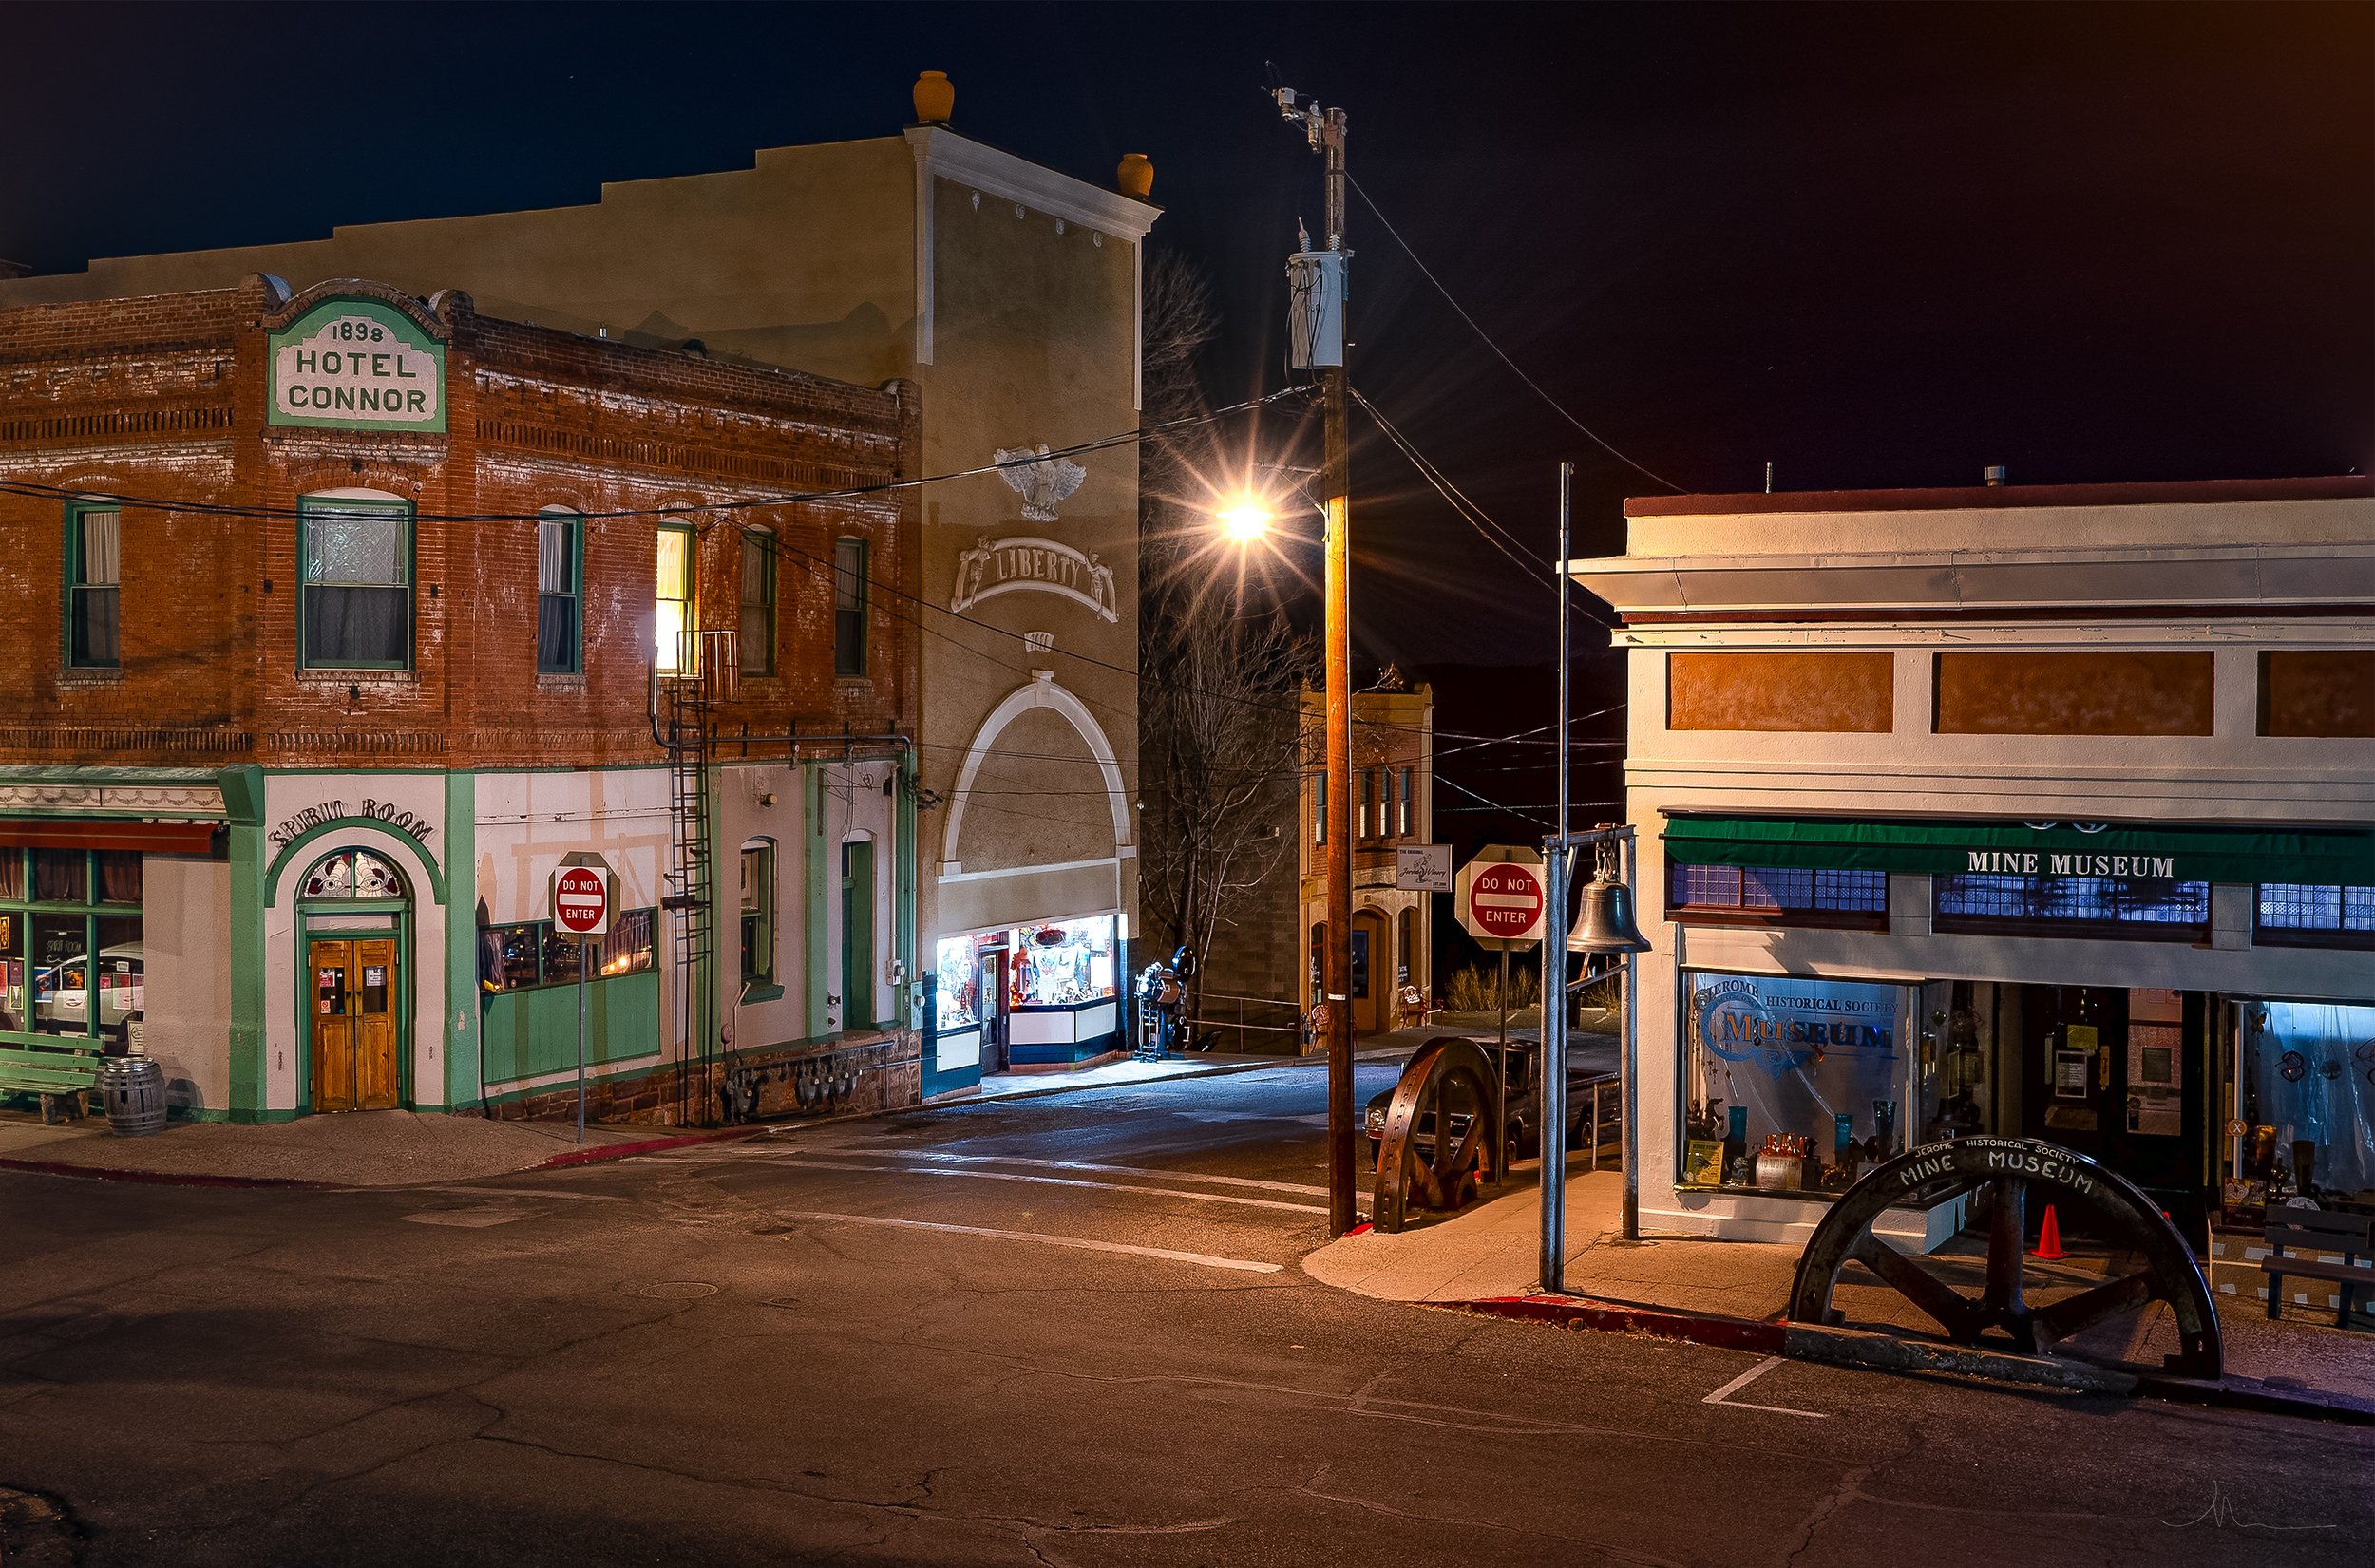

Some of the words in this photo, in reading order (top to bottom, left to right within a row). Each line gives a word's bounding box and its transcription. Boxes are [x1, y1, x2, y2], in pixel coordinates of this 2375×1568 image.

[332, 321, 384, 343] 1898
[296, 349, 416, 378] HOTEL
[288, 385, 427, 413] CONNOR
[996, 548, 1075, 587] LIBERTY
[268, 799, 345, 849] SPIRIT
[361, 798, 435, 841] ROOM
[1967, 851, 2039, 874] MINE
[2050, 854, 2175, 878] MUSEUM
[562, 879, 576, 891] DO
[580, 880, 598, 891] NOT
[1482, 878, 1499, 890] DO
[1507, 878, 1532, 891] NOT
[566, 908, 595, 920] ENTER
[1486, 910, 1527, 924] ENTER
[1766, 995, 1841, 1011] HISTORICAL
[1844, 998, 1899, 1013] SOCIETY
[1915, 1142, 1954, 1158] JEROME
[1966, 1139, 2028, 1150] HISTORICAL
[2035, 1145, 2080, 1164] SOCIETY
[1900, 1154, 1956, 1186] MINE
[1988, 1150, 2094, 1194] MUSEUM
